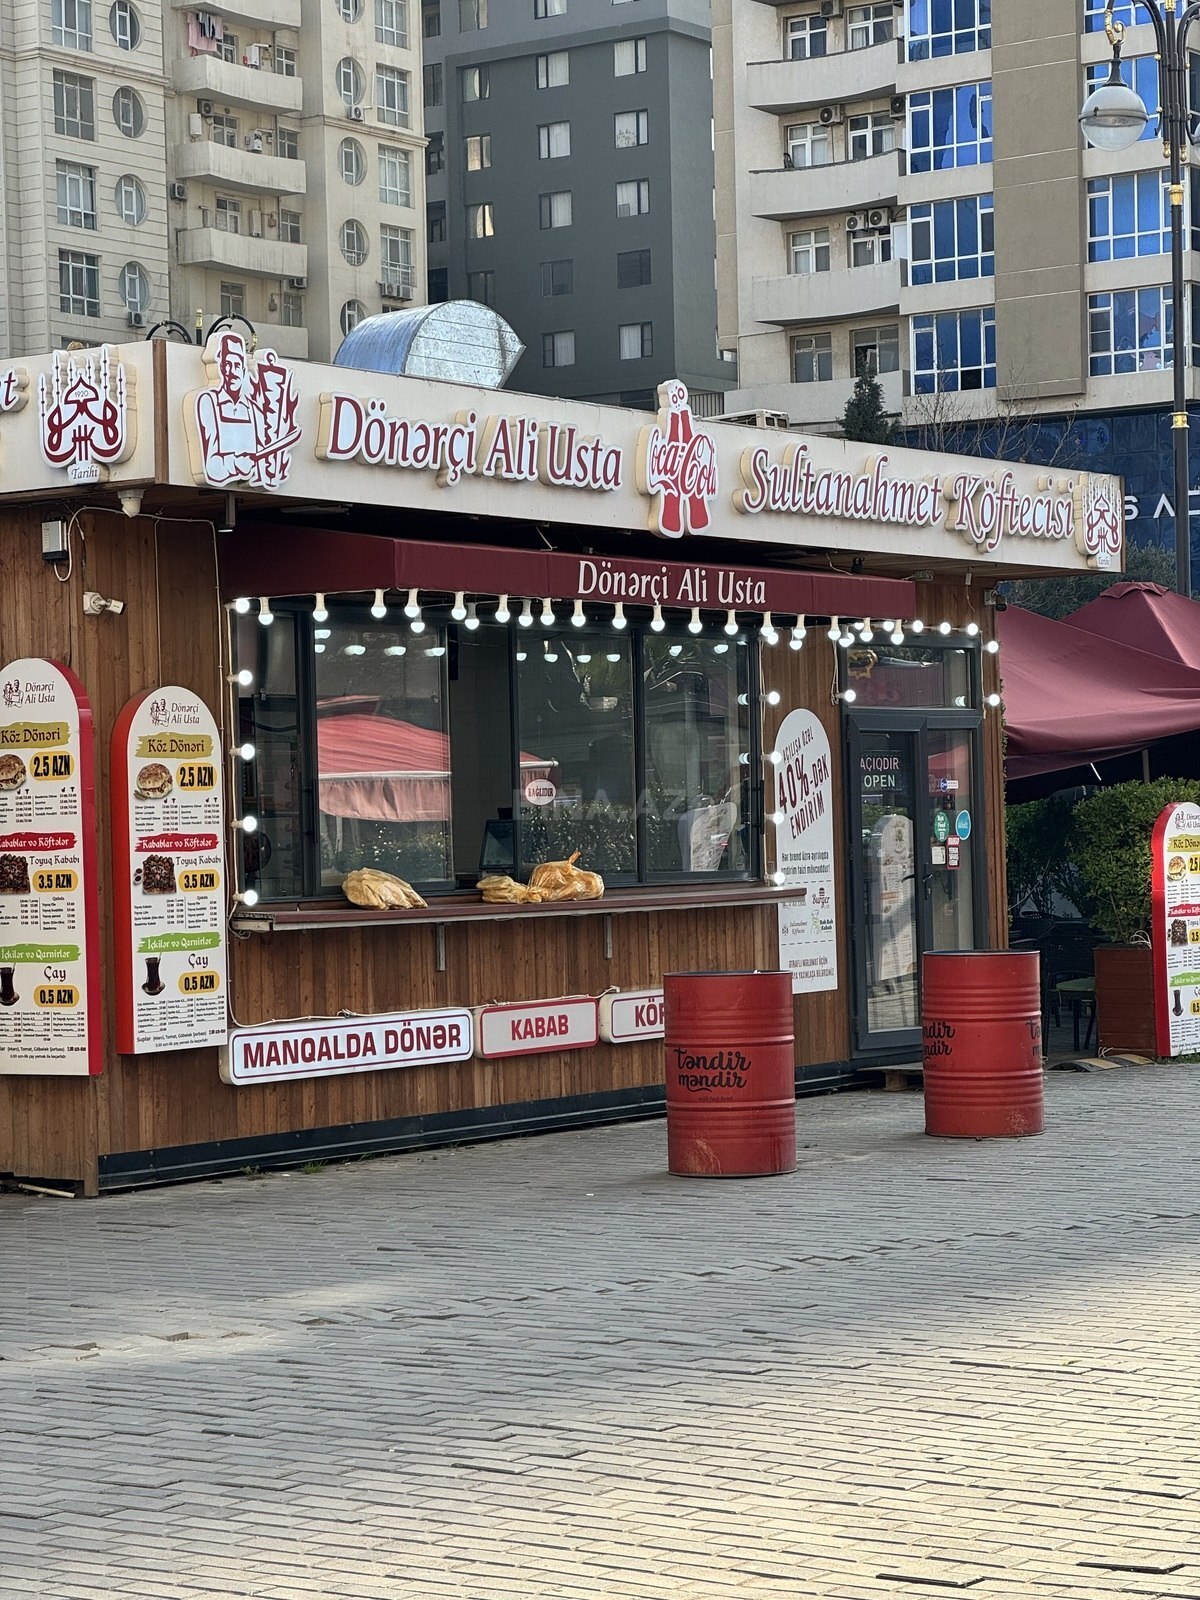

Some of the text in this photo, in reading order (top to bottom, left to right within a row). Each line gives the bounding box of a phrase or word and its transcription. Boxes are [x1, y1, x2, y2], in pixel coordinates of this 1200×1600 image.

[329, 396, 622, 488] Dönərçi Ali Usta
[650, 428, 717, 497] Coca-Cola
[71, 466, 98, 480] Tarihi
[745, 444, 1074, 551] Sultanahmet Köftecisi
[578, 560, 766, 606] Dönərçi Ali Usta
[25, 681, 54, 694] Dönərçi
[25, 693, 55, 704] Ali Usta
[171, 703, 199, 714] Dönərçi
[171, 714, 200, 724] Ali Usta
[1, 728, 60, 743] Köz Dönəri
[148, 739, 204, 753] Köz Dönəri
[33, 755, 70, 777] 2.5 AZN
[860, 756, 899, 771] AÇIQDIR
[180, 766, 214, 787] 2.5 AZN
[864, 775, 895, 787] OPEN
[790, 790, 825, 840] ENDİRİM
[0, 838, 26, 849] abablar
[38, 837, 69, 849] Köftələr
[142, 839, 173, 849] Kabablar
[184, 838, 212, 849] Köftələr
[29, 854, 79, 867] Toyuq Kababı
[175, 855, 221, 867] Toyuq Kababı
[38, 873, 72, 889] 3.5 AZN
[184, 873, 214, 888] 3.5 AZN
[181, 937, 212, 948] Qarnirlər
[35, 949, 70, 960] Qarnirlər
[188, 953, 209, 968] Çay
[44, 965, 66, 982] Çay
[184, 975, 214, 991] 0.5 AZN
[40, 989, 73, 1004] 0.5 AZN
[511, 1014, 569, 1040] KABAB
[243, 1021, 461, 1069] MANQALDA DÖNƏR
[678, 1071, 748, 1092] məndir
